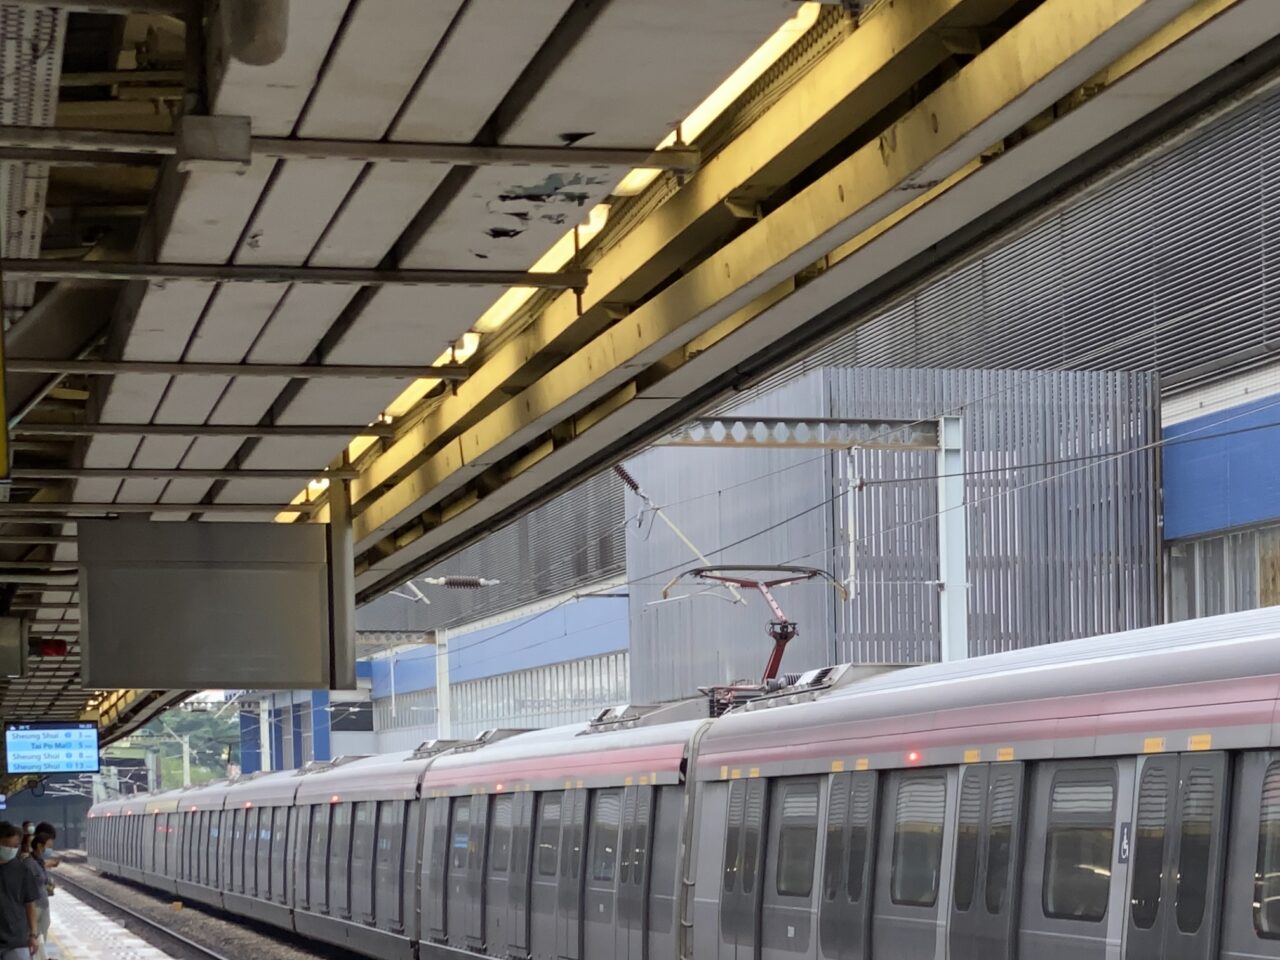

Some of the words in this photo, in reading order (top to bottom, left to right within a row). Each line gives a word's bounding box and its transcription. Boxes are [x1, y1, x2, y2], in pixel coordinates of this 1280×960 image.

[12, 732, 40, 740] Sheung
[13, 753, 41, 761] Sheung
[13, 763, 41, 771] Sheung
